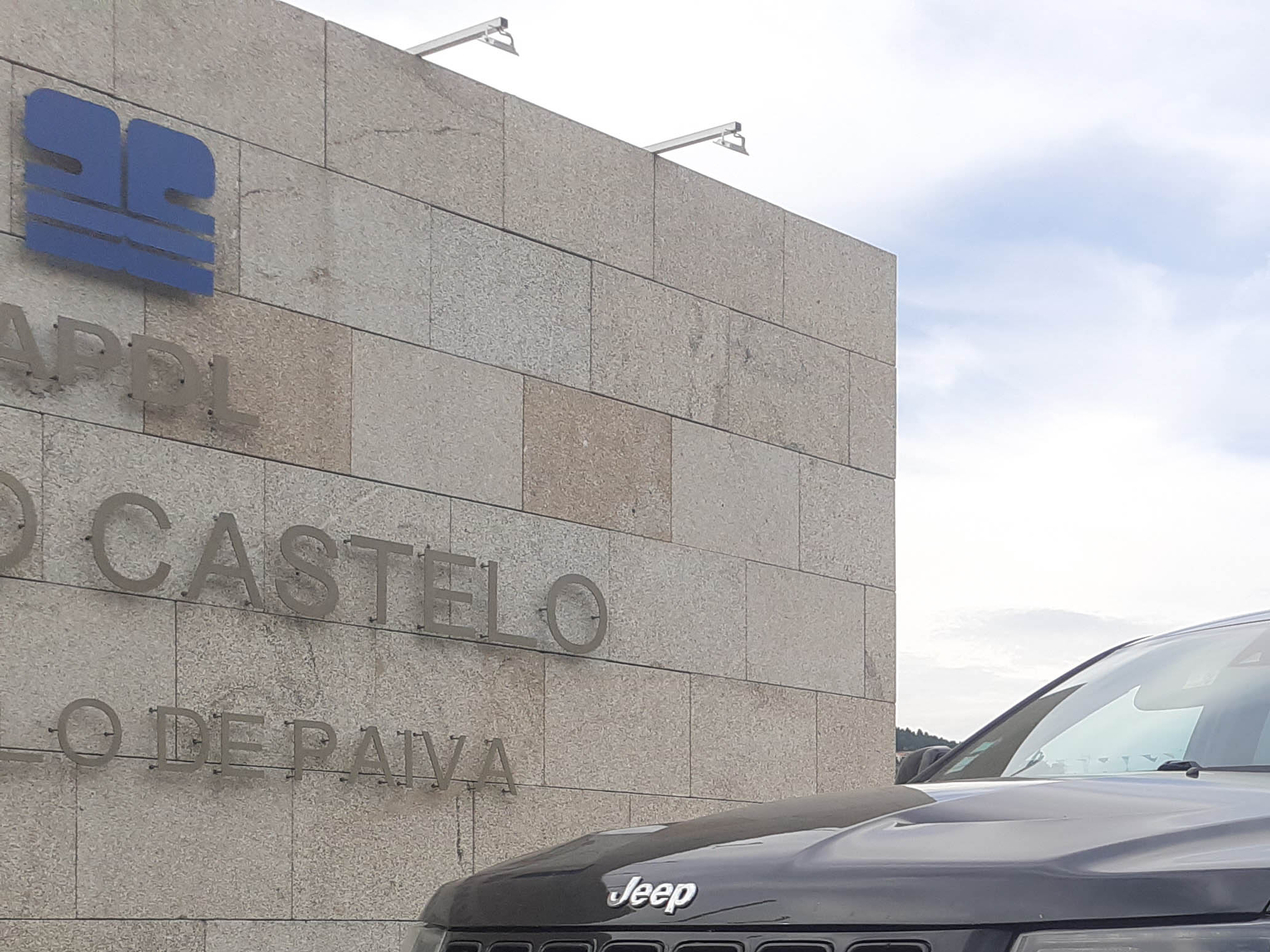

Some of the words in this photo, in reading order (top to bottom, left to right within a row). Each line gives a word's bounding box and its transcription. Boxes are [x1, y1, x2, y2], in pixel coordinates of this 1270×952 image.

[0, 303, 259, 427] APDL
[91, 492, 608, 654] CASTELO
[0, 698, 122, 768] O
[157, 705, 265, 778] DE
[294, 719, 518, 796] PAIVA
[607, 876, 697, 915] Jeep
